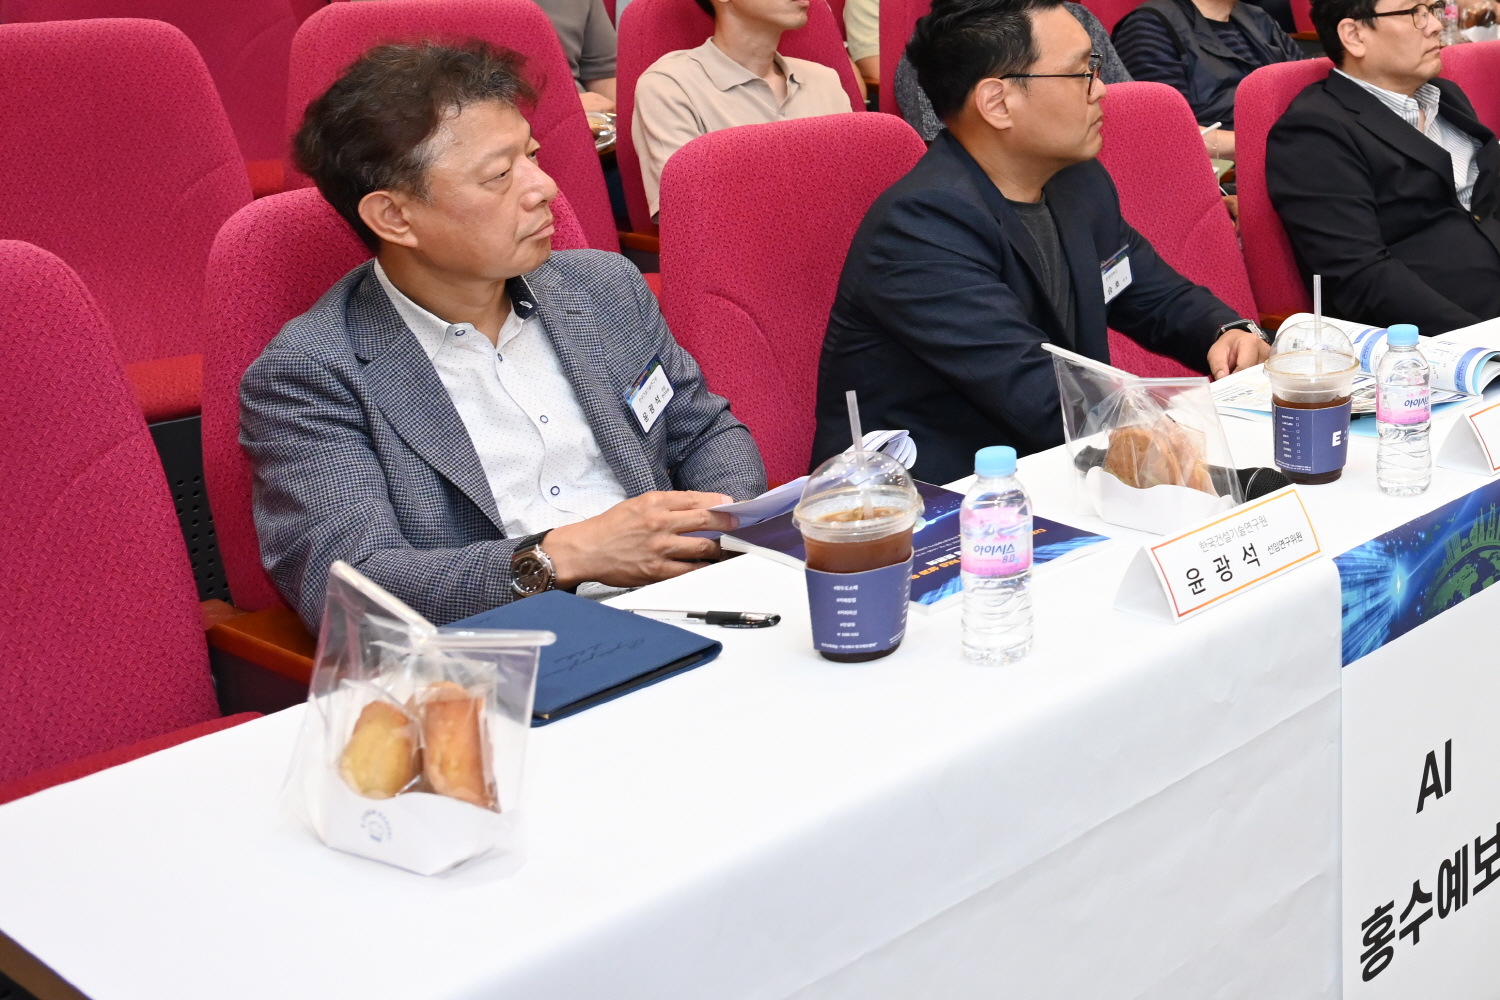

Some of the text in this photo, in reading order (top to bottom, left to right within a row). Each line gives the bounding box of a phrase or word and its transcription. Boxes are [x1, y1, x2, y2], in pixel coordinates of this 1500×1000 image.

[1198, 515, 1269, 554] 한국건설기술연구원
[1267, 531, 1304, 555] 선임연구위원
[973, 543, 1015, 556] 아이시스
[1002, 554, 1015, 564] 8.0
[1416, 738, 1452, 815] AI
